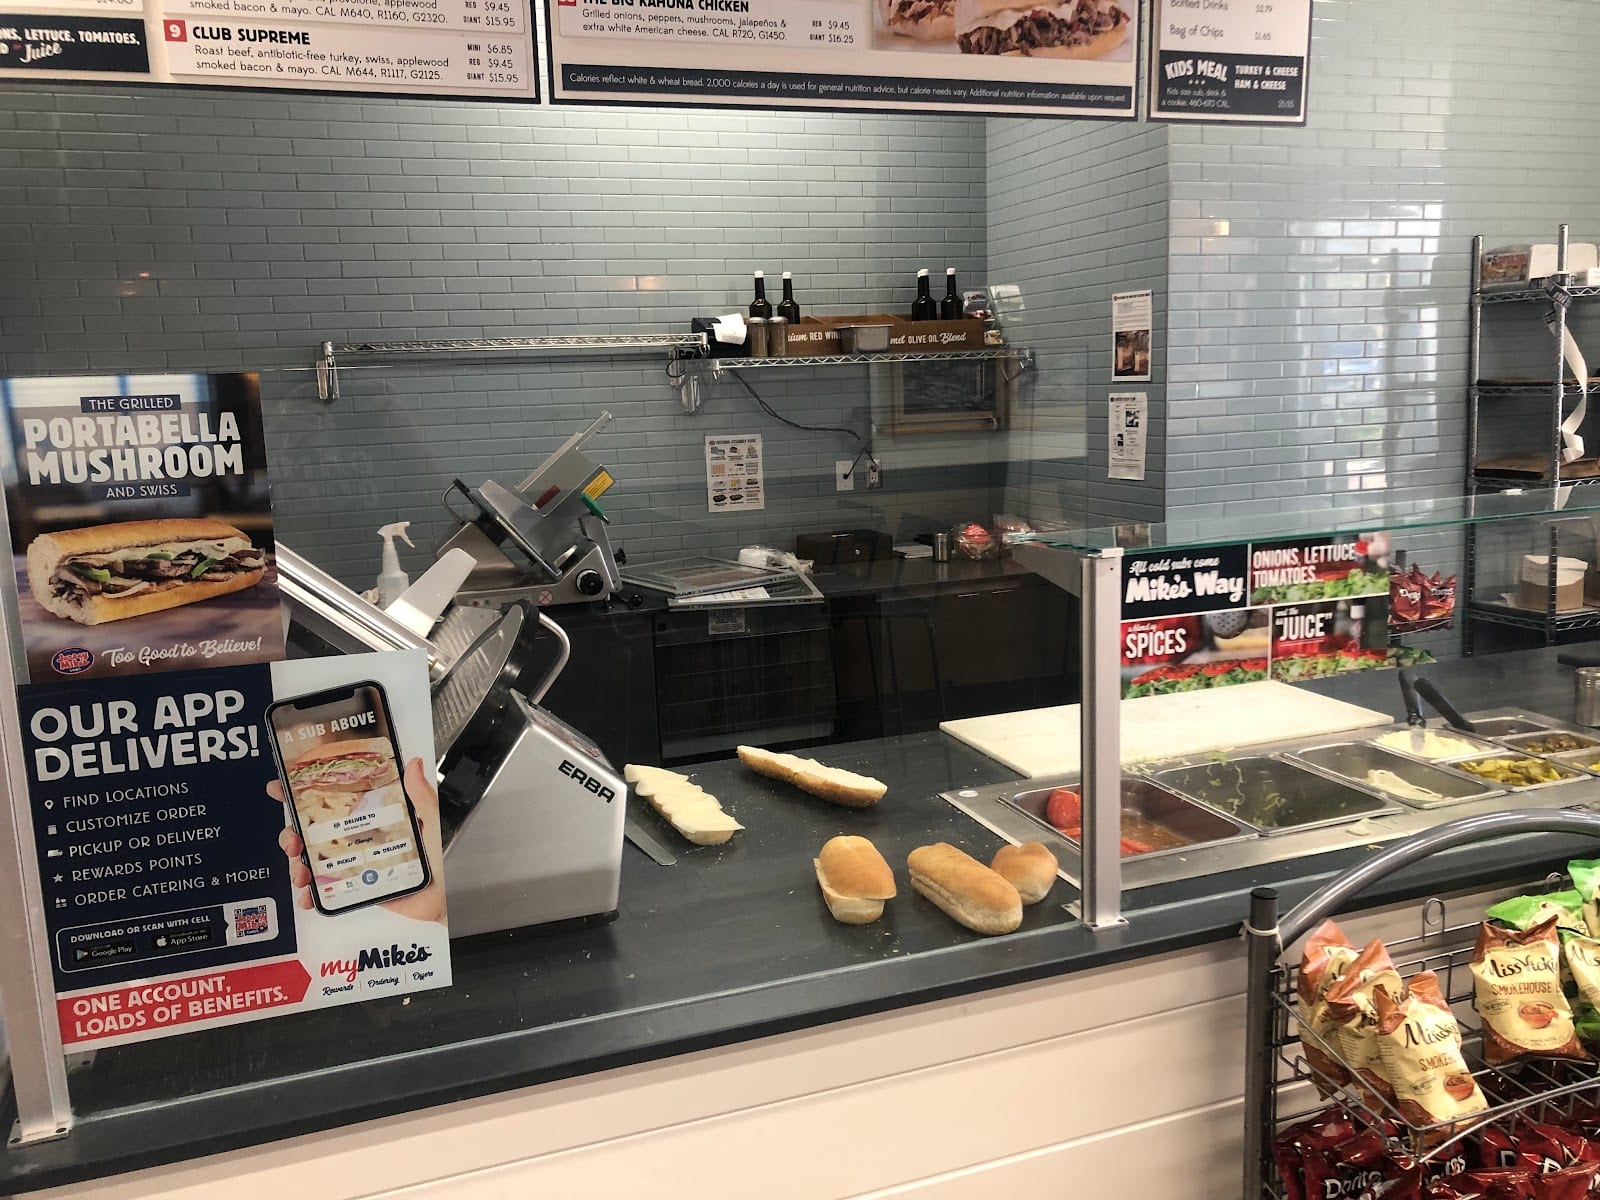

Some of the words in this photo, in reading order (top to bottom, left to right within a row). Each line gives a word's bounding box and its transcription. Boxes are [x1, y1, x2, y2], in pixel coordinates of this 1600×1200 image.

[190, 1, 229, 10] smoked
[234, 1, 265, 11] bacon
[271, 4, 278, 12] &
[282, 7, 312, 16] mayo.
[316, 7, 335, 16] CAL
[341, 10, 373, 20] M640,
[378, 12, 408, 21] R1160,
[413, 13, 448, 23] G2320.
[485, 1, 509, 12] $9.45
[698, 0, 749, 12] CHICKEN
[486, 16, 515, 26] $15.95
[582, 9, 610, 18] Grilled
[614, 12, 645, 21] onions,
[648, 15, 684, 23] peppers,
[687, 15, 736, 26] mushrooms,
[739, 18, 777, 28] jalapeños
[781, 20, 787, 28] &
[828, 20, 849, 30] $9.45
[24, 29, 75, 42] LETTUCE,
[78, 31, 140, 45] TOMATOES,
[169, 24, 181, 38] 9
[193, 26, 232, 40] CLUB
[238, 29, 311, 45] SUPREME
[583, 23, 604, 31] extra
[608, 24, 631, 32] white
[635, 25, 673, 34] American
[678, 27, 709, 37] cheese.
[713, 29, 729, 37] CAL
[733, 30, 756, 40] R720,
[759, 31, 787, 40] G1450.
[829, 33, 853, 43] $16.25
[1170, 24, 1185, 39] Bag
[1189, 25, 1198, 36] of
[1201, 26, 1223, 39] Chips
[20, 42, 62, 63] Juice
[195, 45, 223, 54] Roast
[228, 47, 253, 58] beef,
[258, 49, 325, 60] antibiotic-free
[330, 54, 362, 66] turkey,
[365, 55, 393, 65] swiss,
[397, 57, 448, 69] applewood
[467, 43, 480, 51] MINI
[488, 44, 512, 54] $6.85
[197, 60, 236, 70] smoked
[241, 62, 272, 72] bacon
[276, 63, 283, 72] &
[288, 67, 317, 76] mayo.
[322, 66, 341, 75] CAL
[346, 67, 376, 77] M644,
[381, 69, 407, 78] R1117,
[410, 70, 442, 80] G2125.
[489, 58, 513, 68] $9.45
[1165, 60, 1193, 79] KIDS
[1197, 60, 1228, 82] MEAL
[1236, 65, 1263, 75] TURKEY
[1265, 66, 1271, 75] &
[1273, 66, 1298, 76] CHEESE
[489, 73, 518, 82] $15.95
[570, 73, 600, 83] Calories
[602, 74, 625, 83] reflect
[627, 76, 647, 84] white
[658, 78, 680, 86] wheat
[683, 78, 704, 87] bread.
[733, 80, 759, 89] calories
[767, 81, 780, 91] day
[789, 82, 805, 90] used
[807, 82, 816, 90] for
[819, 83, 843, 93] general
[898, 85, 908, 93] but
[970, 88, 999, 97] Additional
[1235, 80, 1251, 88] HAM
[1253, 81, 1258, 89] &
[1261, 81, 1287, 90] CHEESE
[810, 332, 823, 340] RED
[908, 335, 926, 344] OLIVE
[940, 332, 966, 344] Blend
[89, 399, 114, 411] THE
[120, 398, 174, 410] GRILLED
[23, 412, 241, 449] PORTABELLA
[26, 444, 244, 485] MUSHROOM
[106, 487, 135, 498] AND
[140, 484, 178, 496] SWISS
[1129, 560, 1148, 576] All
[1148, 559, 1171, 572] cold
[1171, 558, 1192, 570] subs
[1194, 558, 1220, 567] come
[1253, 548, 1301, 569] ONIONS,
[1125, 574, 1193, 603] Mike's
[1193, 570, 1244, 602] Way
[102, 647, 134, 667] Too
[138, 647, 179, 666] Good
[181, 642, 196, 658] to
[199, 637, 262, 658] Believe!
[1125, 628, 1187, 659] SPICES
[30, 700, 139, 742] OUR
[154, 690, 245, 730] APP
[284, 731, 294, 744] A
[299, 723, 326, 740] SUB
[331, 711, 376, 733] ABOVE
[35, 725, 259, 782] DELIVERS!
[558, 760, 615, 803] ERBA
[63, 794, 99, 809] FIND
[106, 783, 189, 803] LOCATIONS
[66, 811, 151, 833] CUSTOMIZE
[157, 804, 206, 821] ORDER
[69, 840, 123, 857] PICKUP
[129, 837, 151, 849] OR
[157, 826, 221, 846] DELIVERY
[72, 862, 143, 881] REWARDS
[149, 853, 203, 870] POINTS
[75, 889, 127, 906] ORDER
[132, 877, 205, 898] CATERING
[211, 877, 220, 885] &
[225, 868, 271, 884] MORE!
[70, 928, 124, 943] DOWNLOAD
[127, 925, 140, 933] OR
[142, 922, 165, 932] SCAN
[167, 918, 189, 929] WITH
[191, 915, 210, 924] CELL
[187, 934, 208, 942] Store
[368, 975, 400, 988] Ordering
[1491, 982, 1552, 995] SMOKEHOUSE
[73, 994, 121, 1016] ONE
[128, 975, 231, 1008] ACCOUNT,
[75, 1013, 146, 1037] LOADS
[153, 1004, 182, 1022] OF
[189, 986, 288, 1018] BENEFITS.
